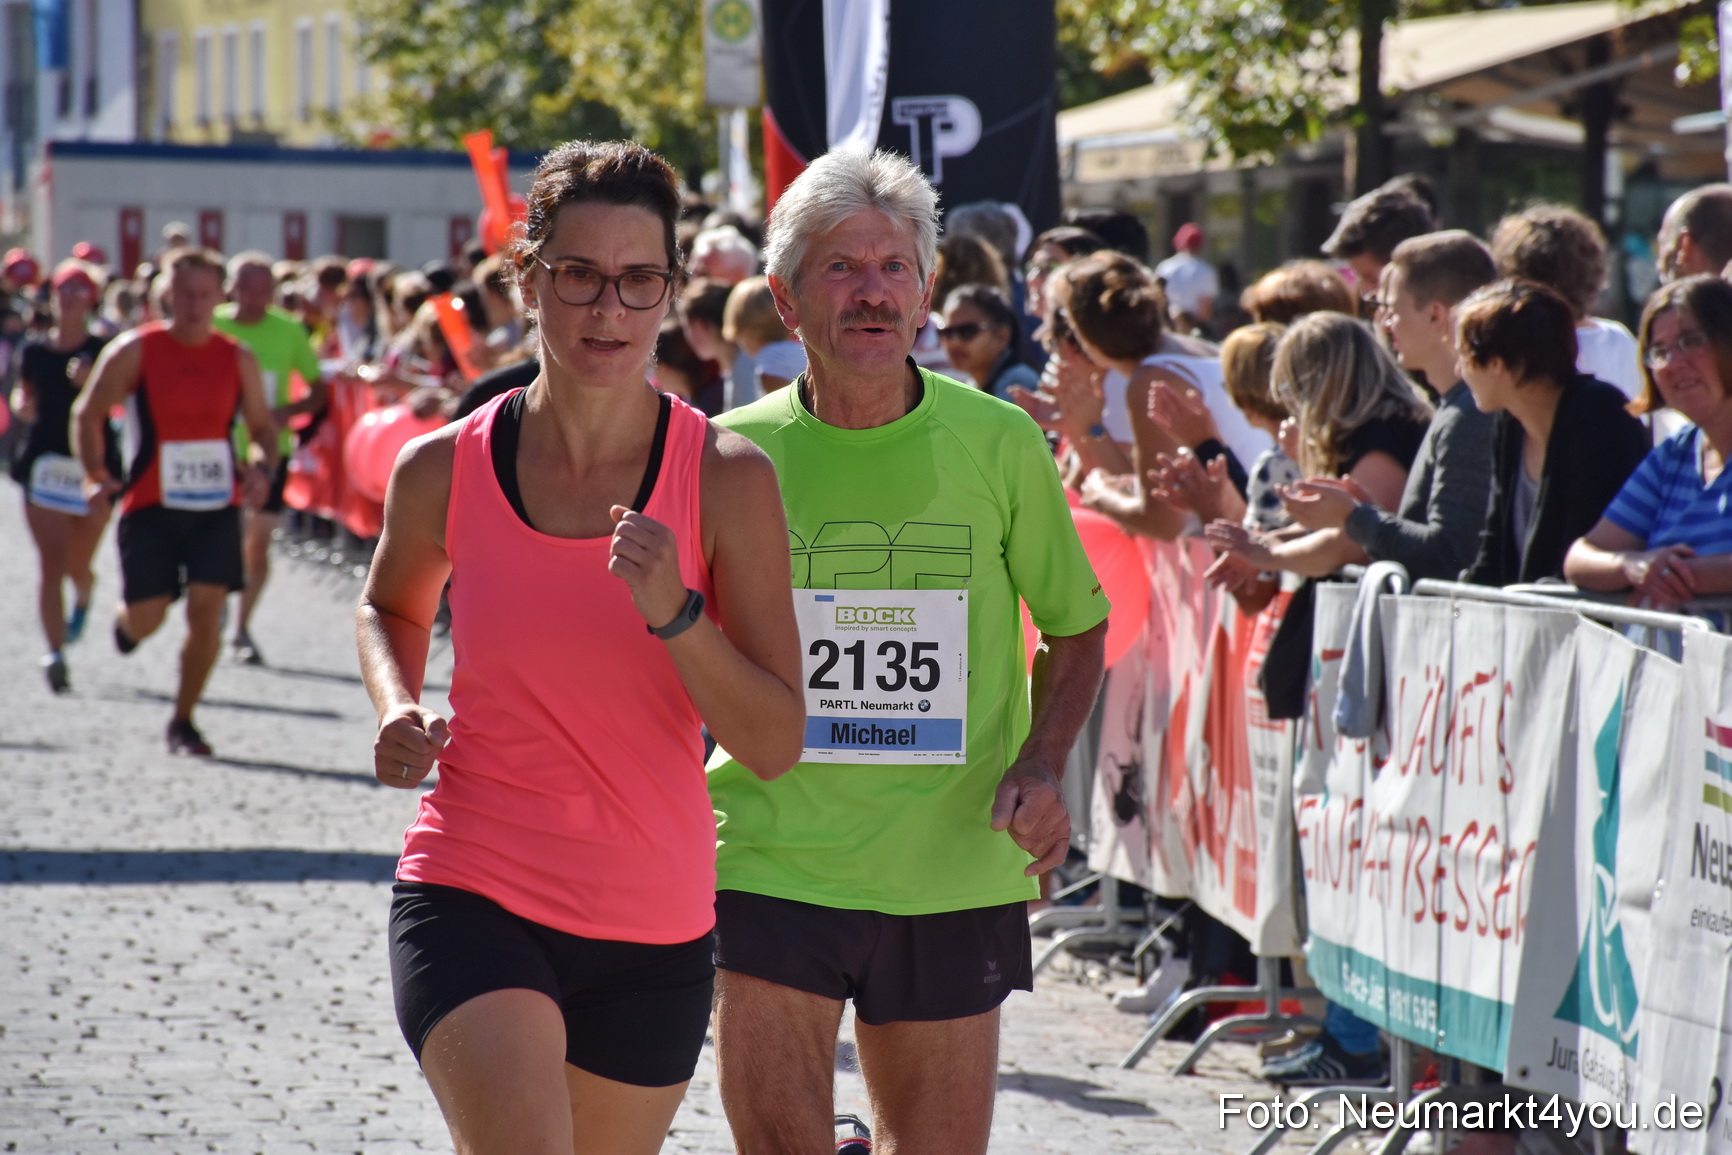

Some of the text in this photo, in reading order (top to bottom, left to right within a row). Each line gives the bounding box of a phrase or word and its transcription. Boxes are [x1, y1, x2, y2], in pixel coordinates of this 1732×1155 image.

[835, 606, 917, 625] BOCK
[835, 624, 859, 632] inspired
[859, 625, 869, 633] by
[889, 625, 918, 633] concepts
[808, 638, 941, 692] 2135
[819, 699, 914, 711] PARTL Neumarkt
[830, 722, 917, 746] Michael
